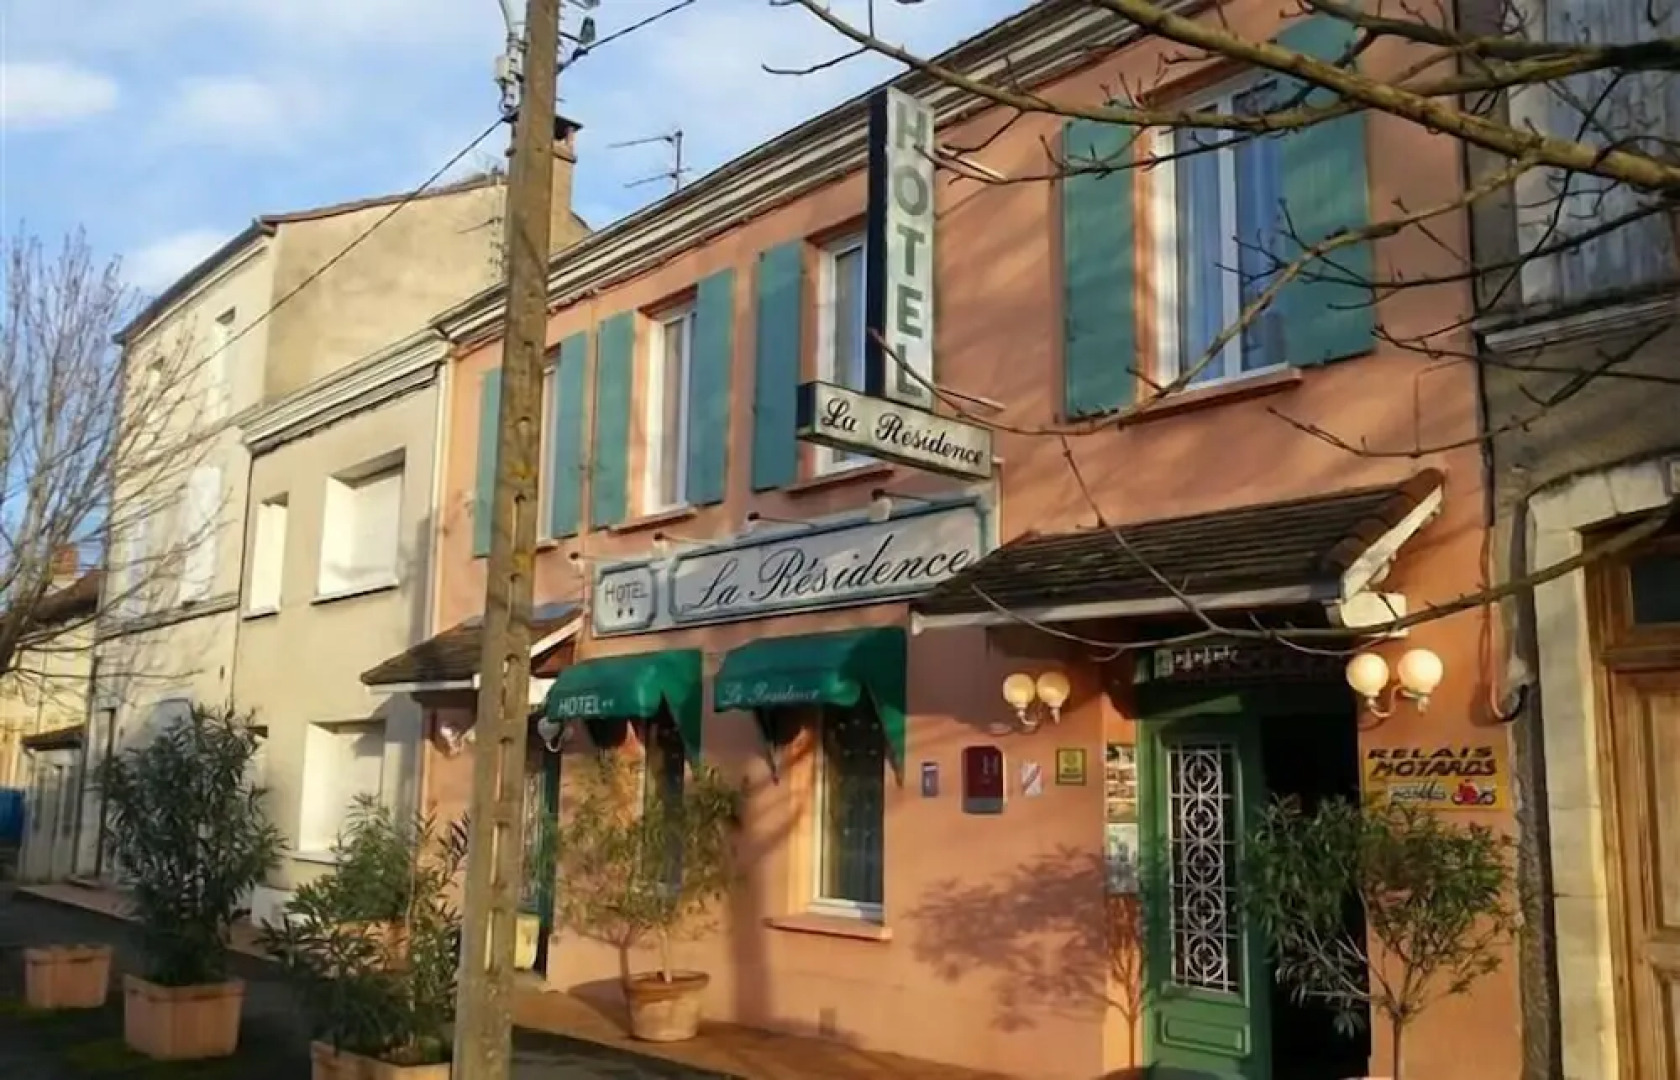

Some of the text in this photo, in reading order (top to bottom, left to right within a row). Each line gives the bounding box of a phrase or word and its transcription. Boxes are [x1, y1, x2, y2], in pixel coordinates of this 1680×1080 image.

[894, 102, 928, 398] HOTEL
[821, 398, 857, 432] La
[692, 532, 971, 609] La Résidence
[605, 581, 649, 603] HOTEL
[558, 695, 600, 715] HOTEL
[1368, 746, 1493, 759] RELAIS
[1370, 759, 1497, 776] MOTARDS
